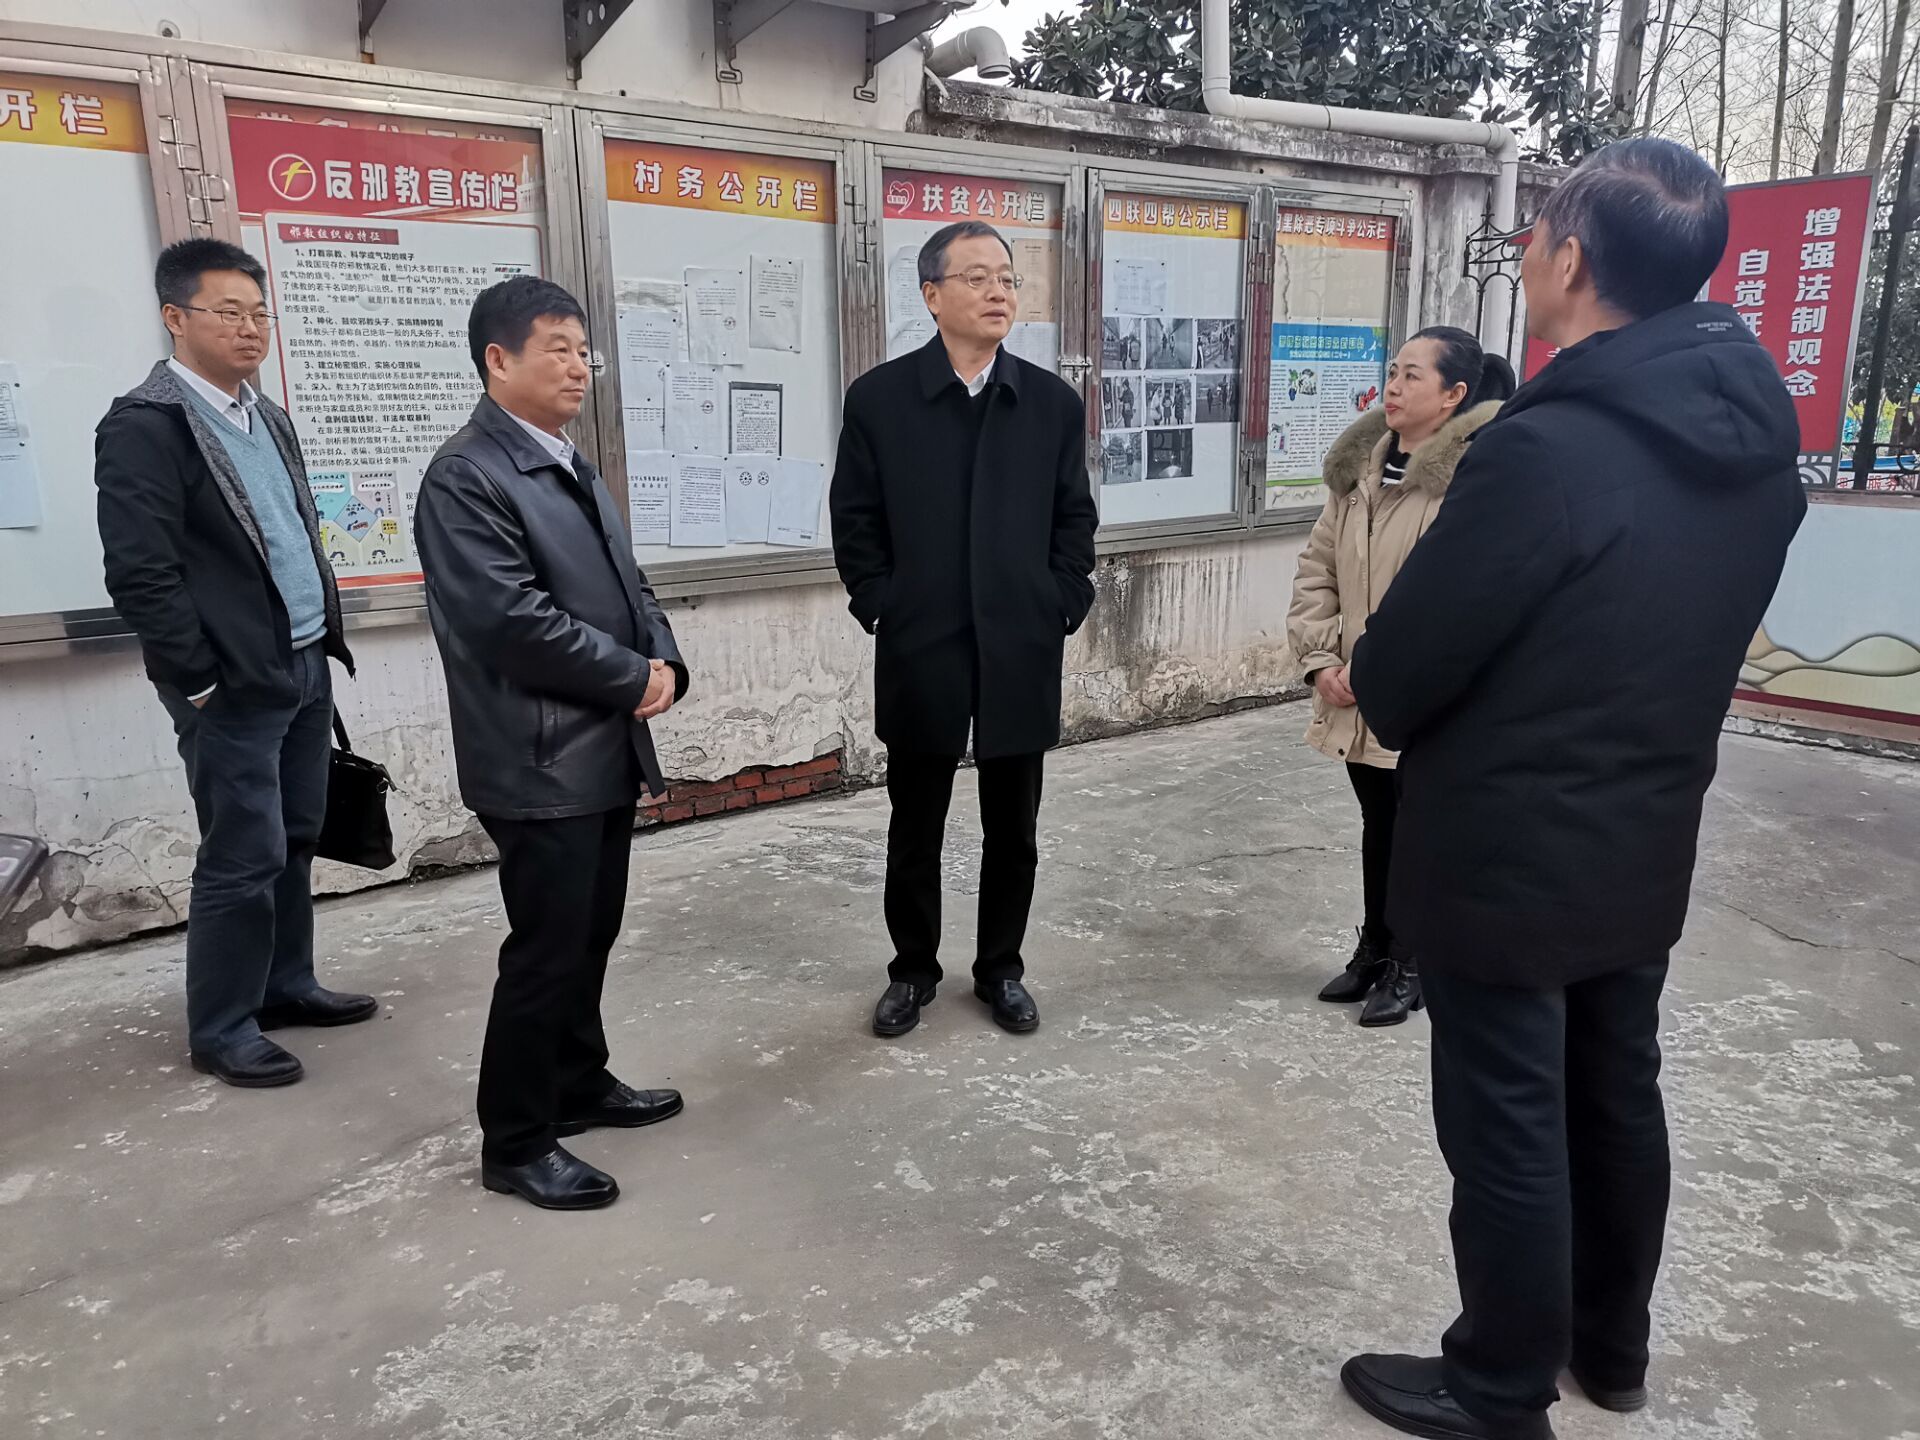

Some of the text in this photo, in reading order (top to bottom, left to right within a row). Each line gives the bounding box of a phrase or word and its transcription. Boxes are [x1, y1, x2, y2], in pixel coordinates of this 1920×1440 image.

[324, 159, 519, 211] 反邪教宣传栏
[634, 159, 818, 211] 村务公开栏
[922, 183, 1045, 221] 扶贫公开栏
[289, 225, 382, 241] 邪教组织的特征
[1108, 198, 1228, 231] 四联四帮公示栏
[1784, 207, 1841, 397] 增强法制观念
